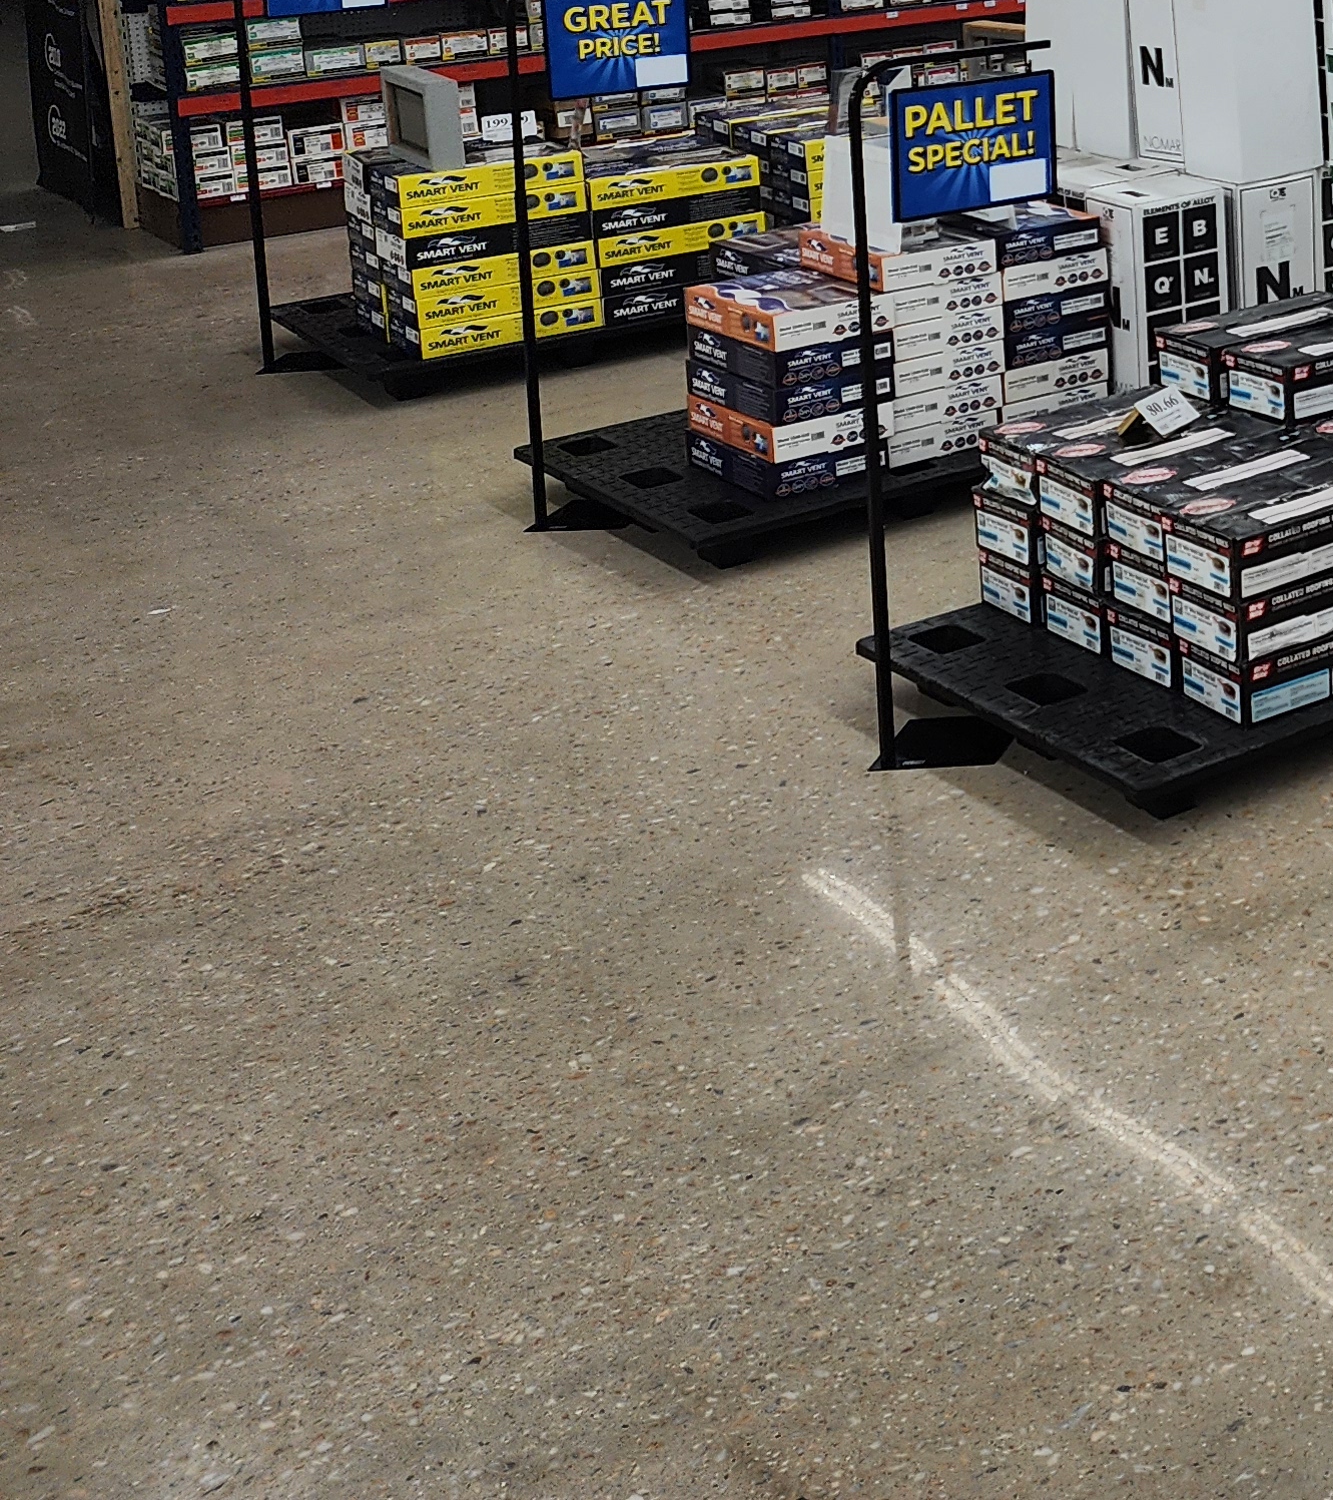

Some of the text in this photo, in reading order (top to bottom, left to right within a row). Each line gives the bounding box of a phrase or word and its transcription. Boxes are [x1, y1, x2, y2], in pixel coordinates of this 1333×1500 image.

[578, 32, 661, 61] PRICE!
[904, 89, 1039, 139] PALLET
[908, 130, 1036, 173] SPECIAL!
[406, 181, 481, 200] SMART VENT
[635, 184, 666, 196] VENT
[1143, 196, 1216, 216] ELEMENTS OF ALLOY
[408, 212, 482, 231] SMART VENT
[601, 213, 669, 231] SMART VENT
[1154, 219, 1207, 245] E B
[416, 241, 488, 261] SMART VENT
[604, 241, 673, 260] SMART VENT
[420, 271, 493, 291] SMART VENT
[610, 269, 676, 288] SMART VENT
[425, 300, 498, 320] SMART VENT
[613, 299, 680, 318] SMART VENT
[428, 330, 502, 351] SMART VENT
[1146, 396, 1179, 417] 80.66
